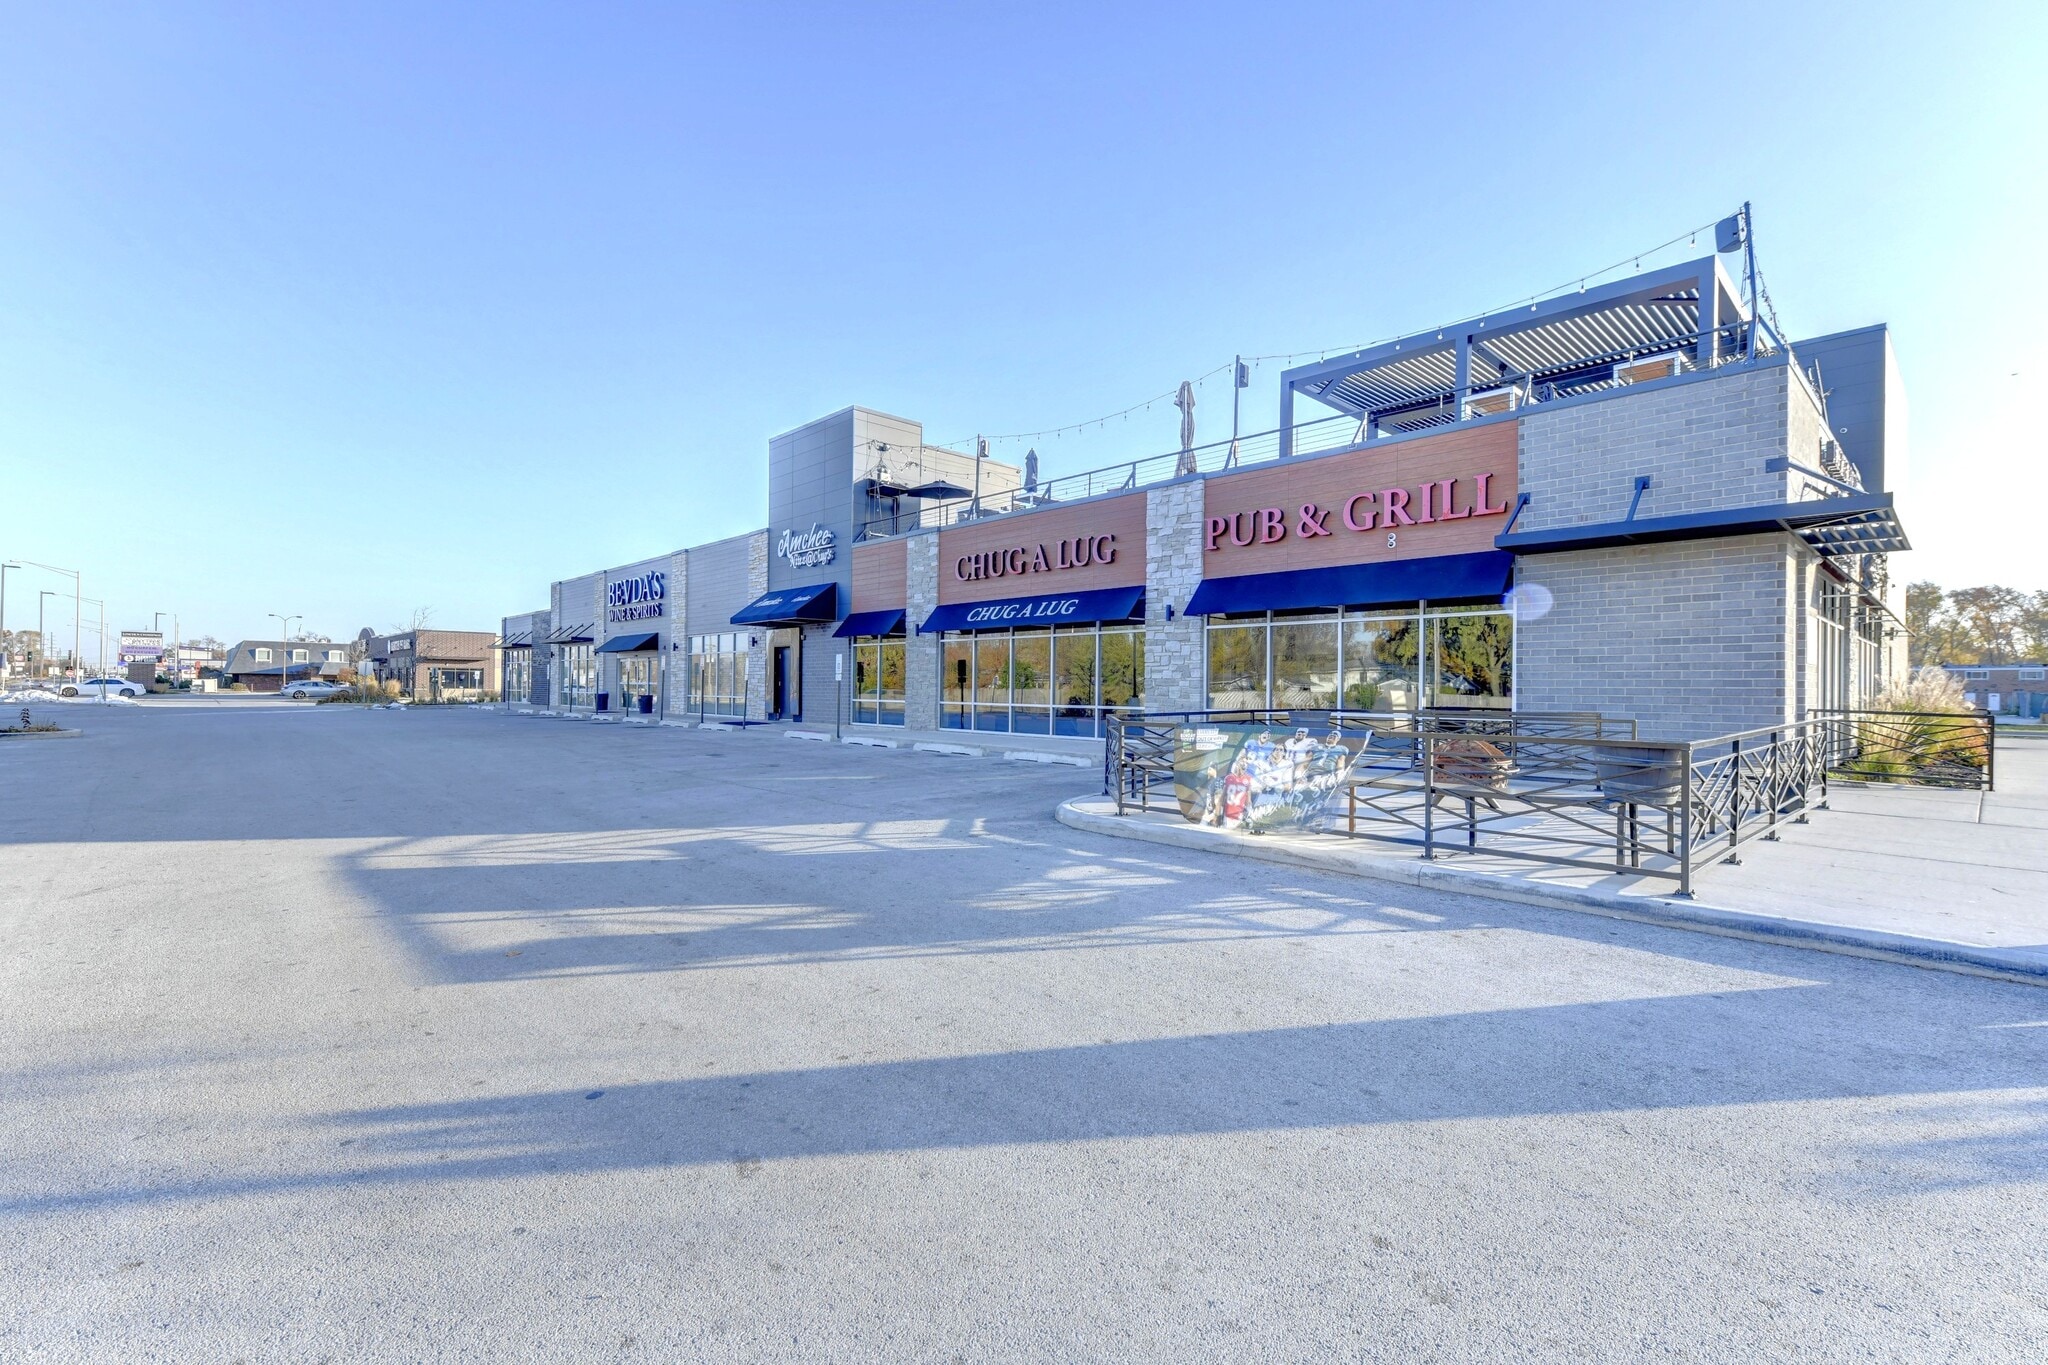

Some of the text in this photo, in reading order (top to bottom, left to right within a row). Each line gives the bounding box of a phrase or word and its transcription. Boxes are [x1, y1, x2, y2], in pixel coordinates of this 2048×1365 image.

[1203, 472, 1510, 551] PUB & GRILL
[777, 522, 835, 558] Amchee
[954, 533, 1117, 582] CHUG A LUG
[608, 570, 663, 607] BEVDA'S
[607, 607, 626, 623] WINE
[632, 602, 661, 621] SPIRITS
[967, 598, 1079, 623] CHUG A LUG
[1226, 783, 1248, 807] 87
